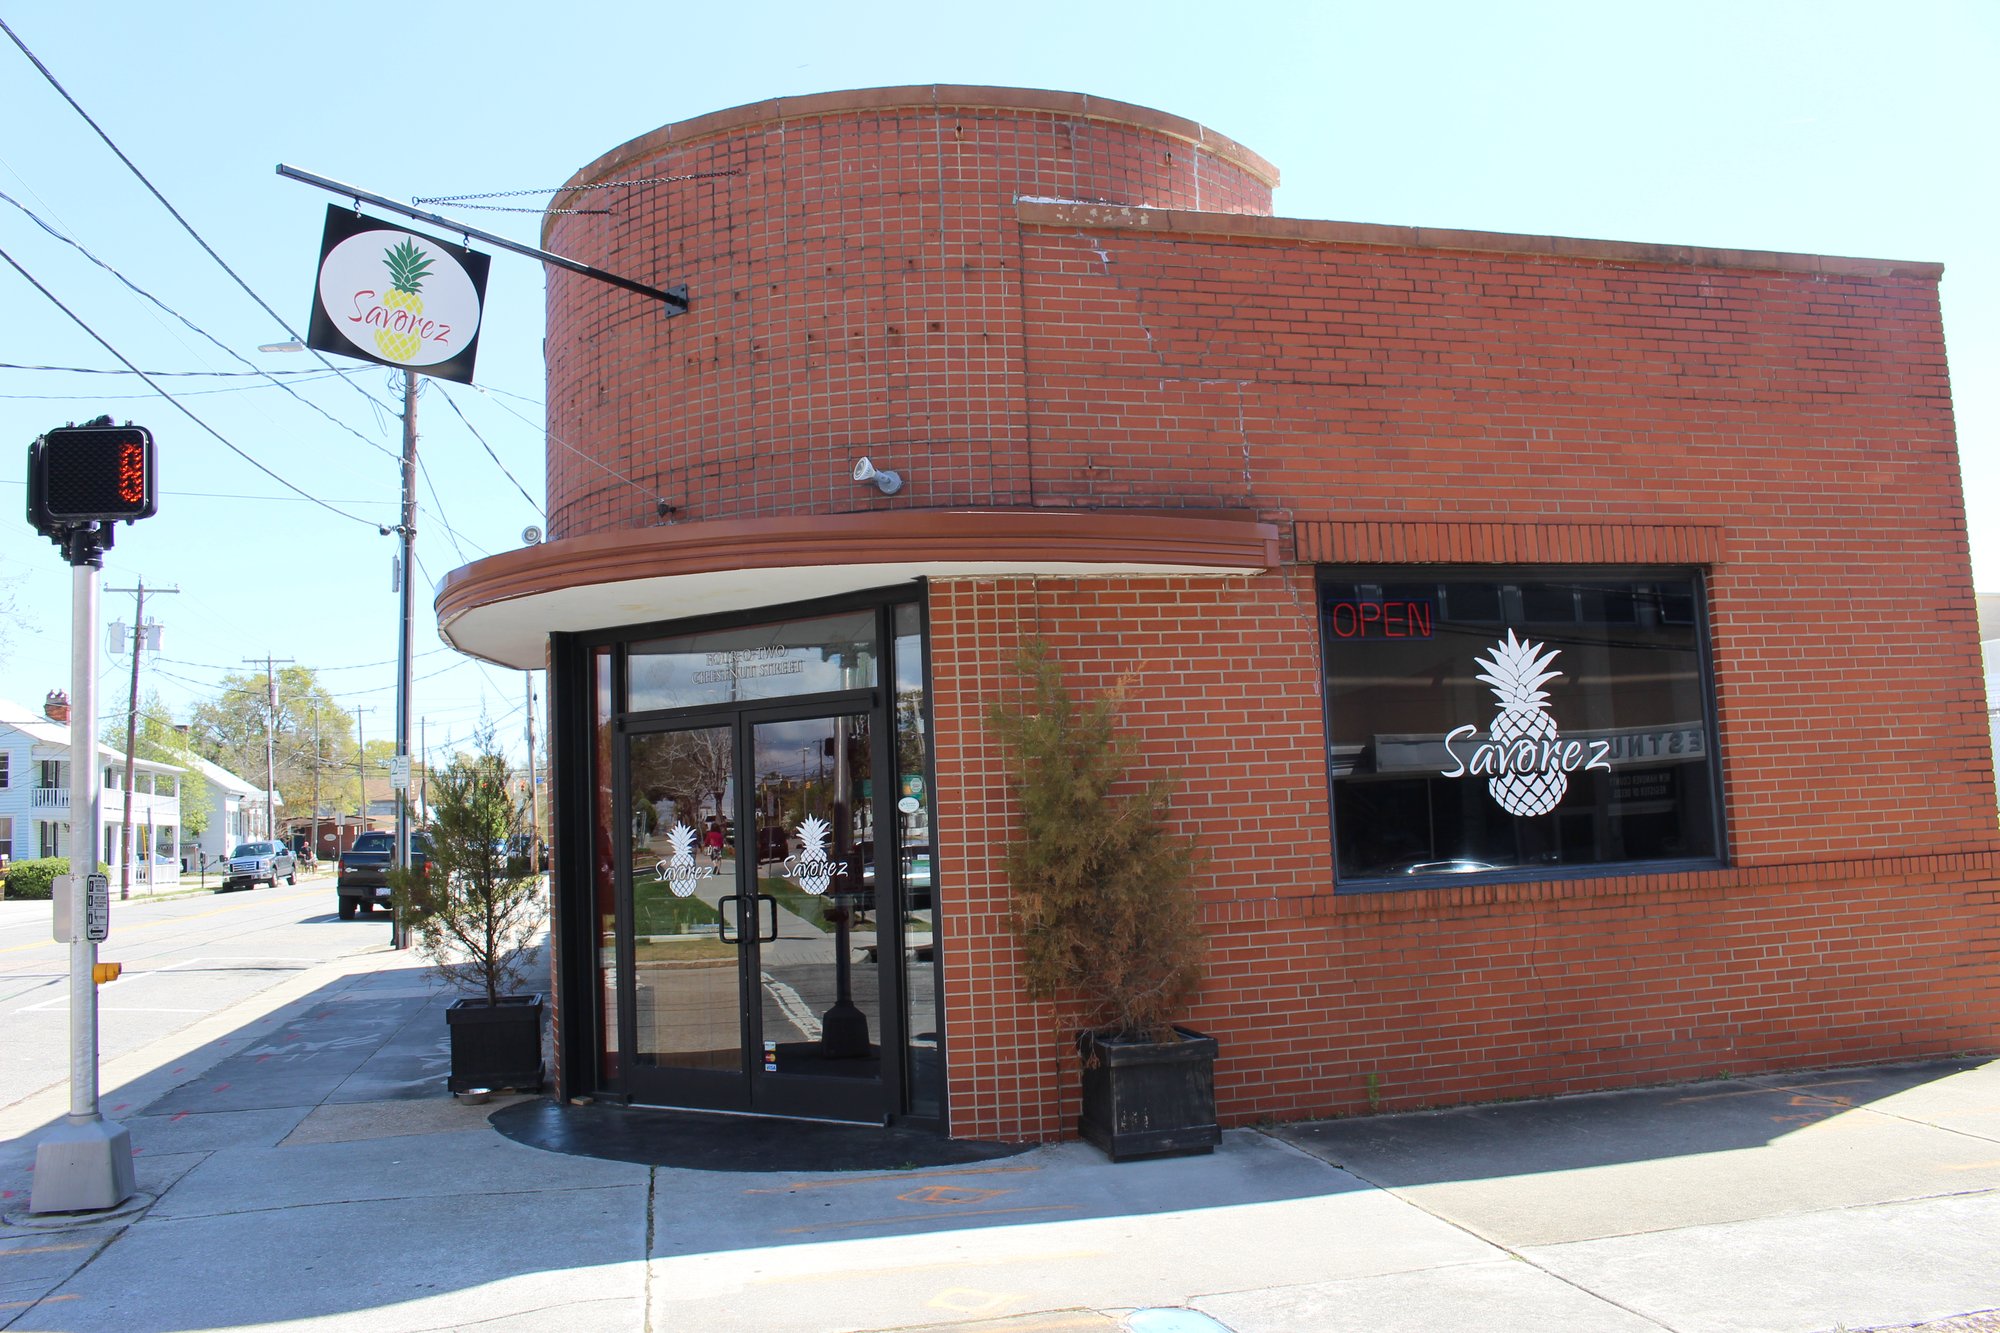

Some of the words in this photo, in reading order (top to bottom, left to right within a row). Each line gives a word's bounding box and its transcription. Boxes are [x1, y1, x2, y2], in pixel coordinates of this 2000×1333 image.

[347, 289, 451, 346] Savorez
[1333, 602, 1432, 638] OPEN
[691, 665, 756, 685] CHESTNUT
[759, 660, 805, 677] STREET
[1440, 724, 1611, 778] Savorez
[654, 859, 713, 882] Savorez
[782, 855, 848, 878] Savorez
